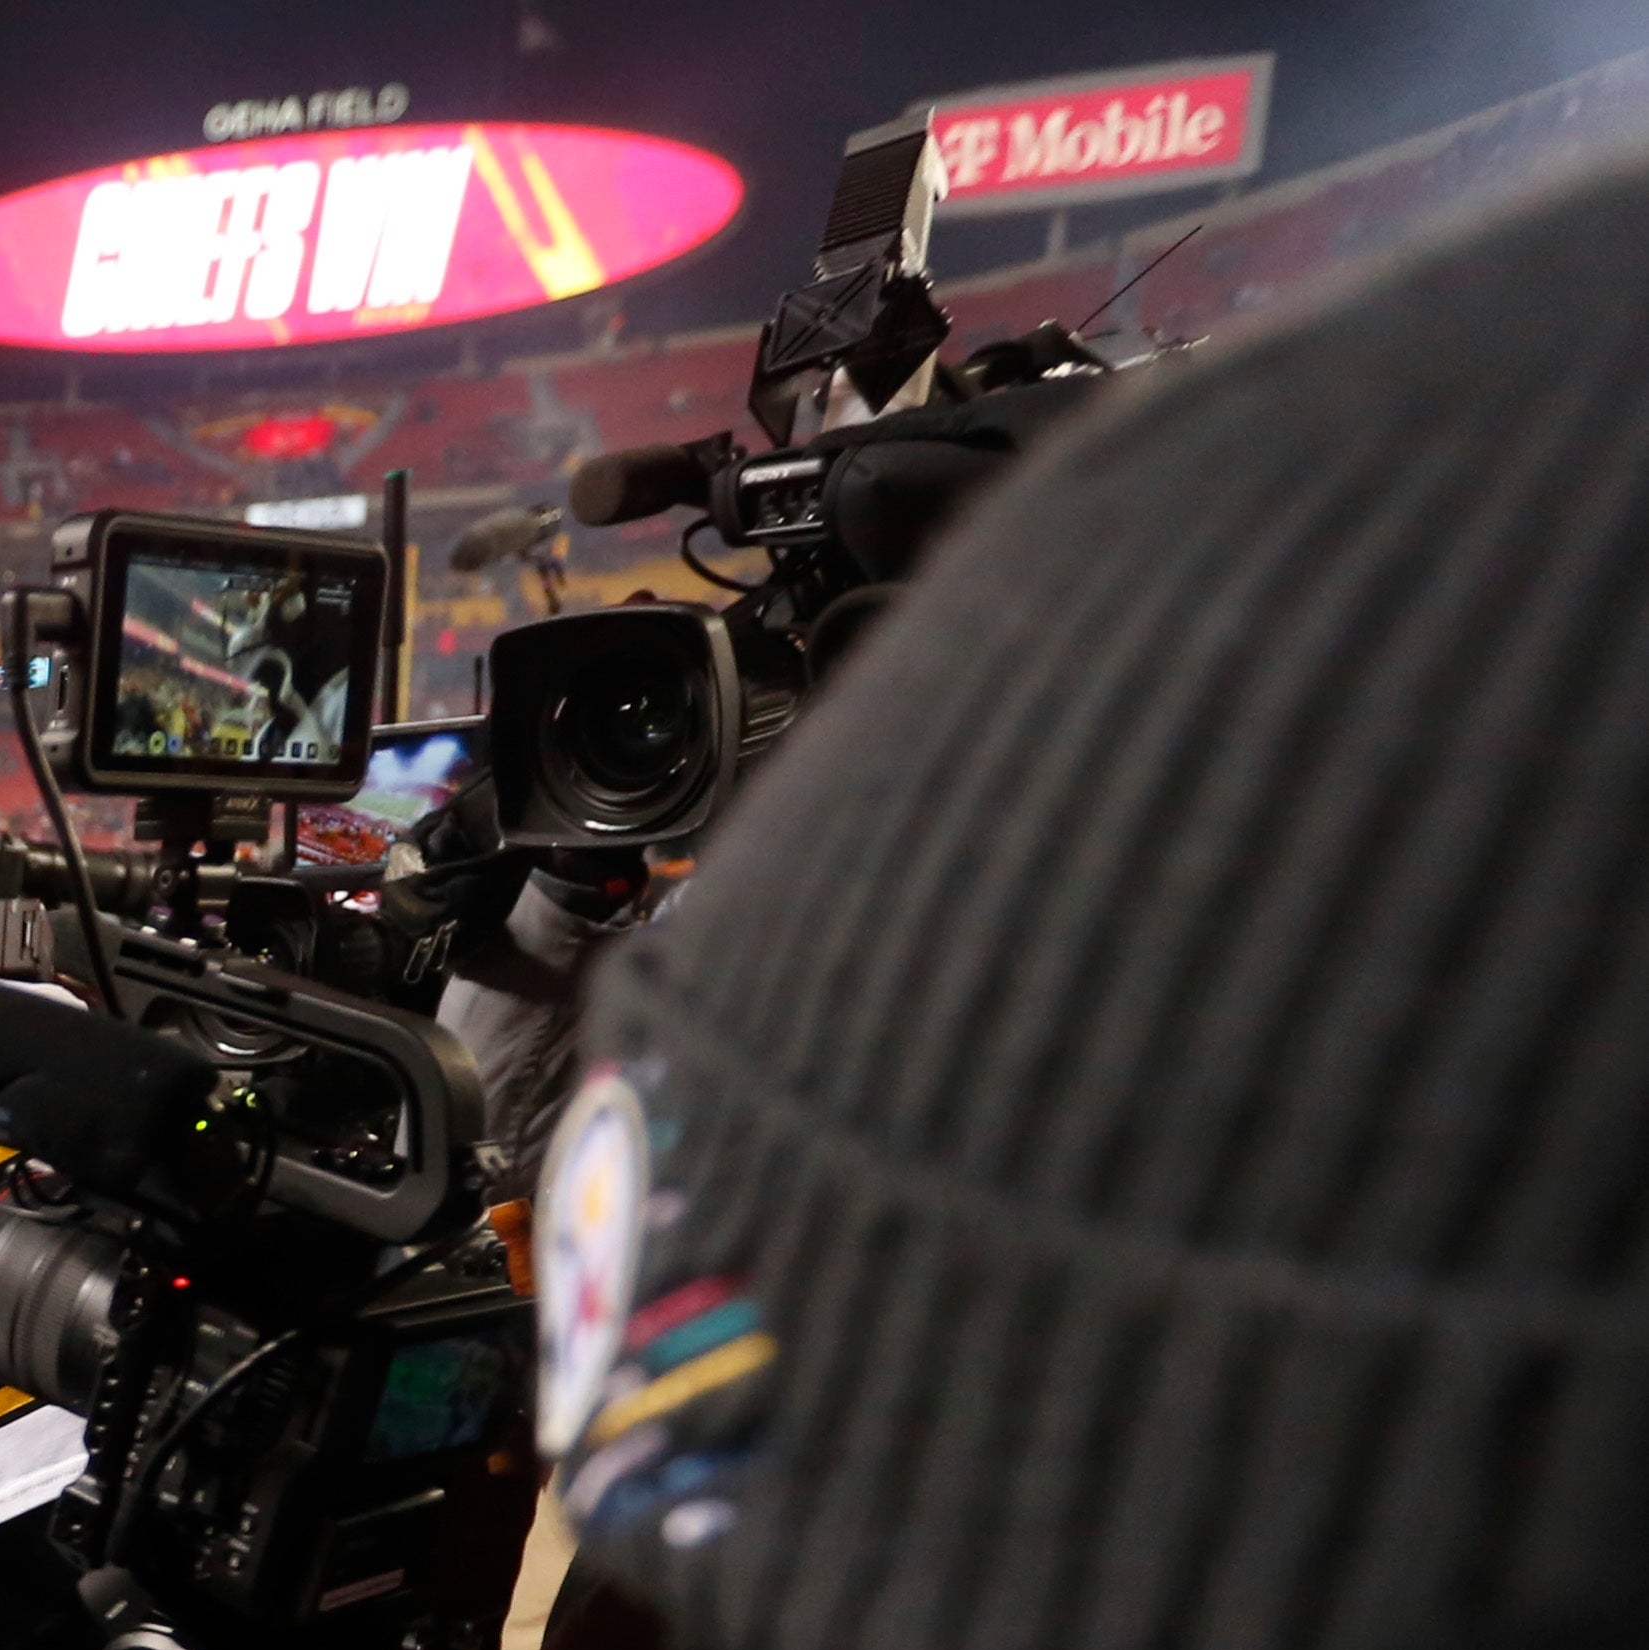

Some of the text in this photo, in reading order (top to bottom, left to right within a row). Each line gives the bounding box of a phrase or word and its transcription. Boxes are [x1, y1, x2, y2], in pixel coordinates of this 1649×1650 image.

[1002, 92, 1225, 182] Mobile
[61, 144, 474, 338] CHIEFS WIN
